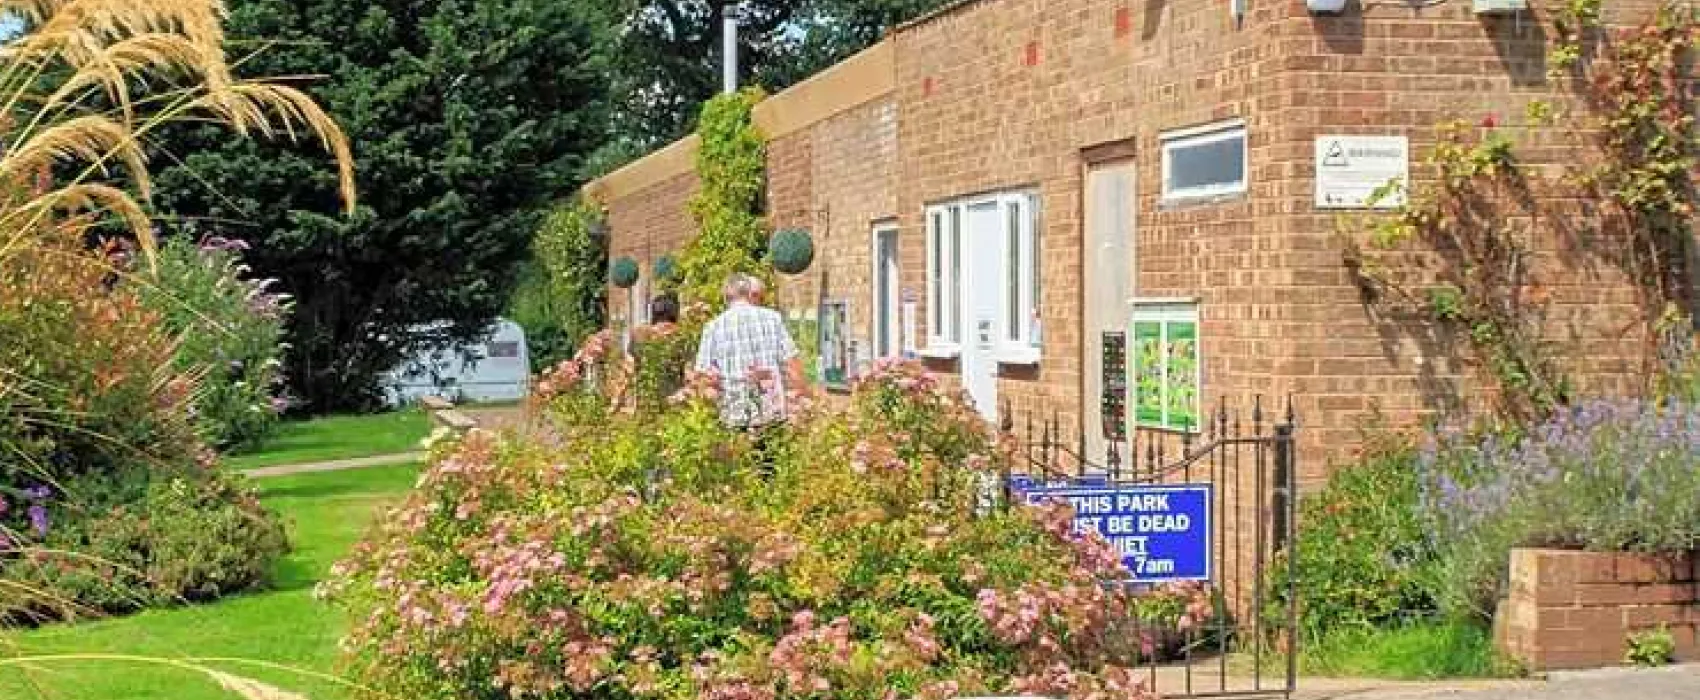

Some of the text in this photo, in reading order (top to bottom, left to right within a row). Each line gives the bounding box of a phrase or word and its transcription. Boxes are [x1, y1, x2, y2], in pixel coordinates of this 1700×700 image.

[1071, 494, 1170, 513] THIS PARK
[1108, 516, 1134, 533] BE
[1138, 514, 1190, 532] DEAD
[1135, 556, 1174, 573] 7am
